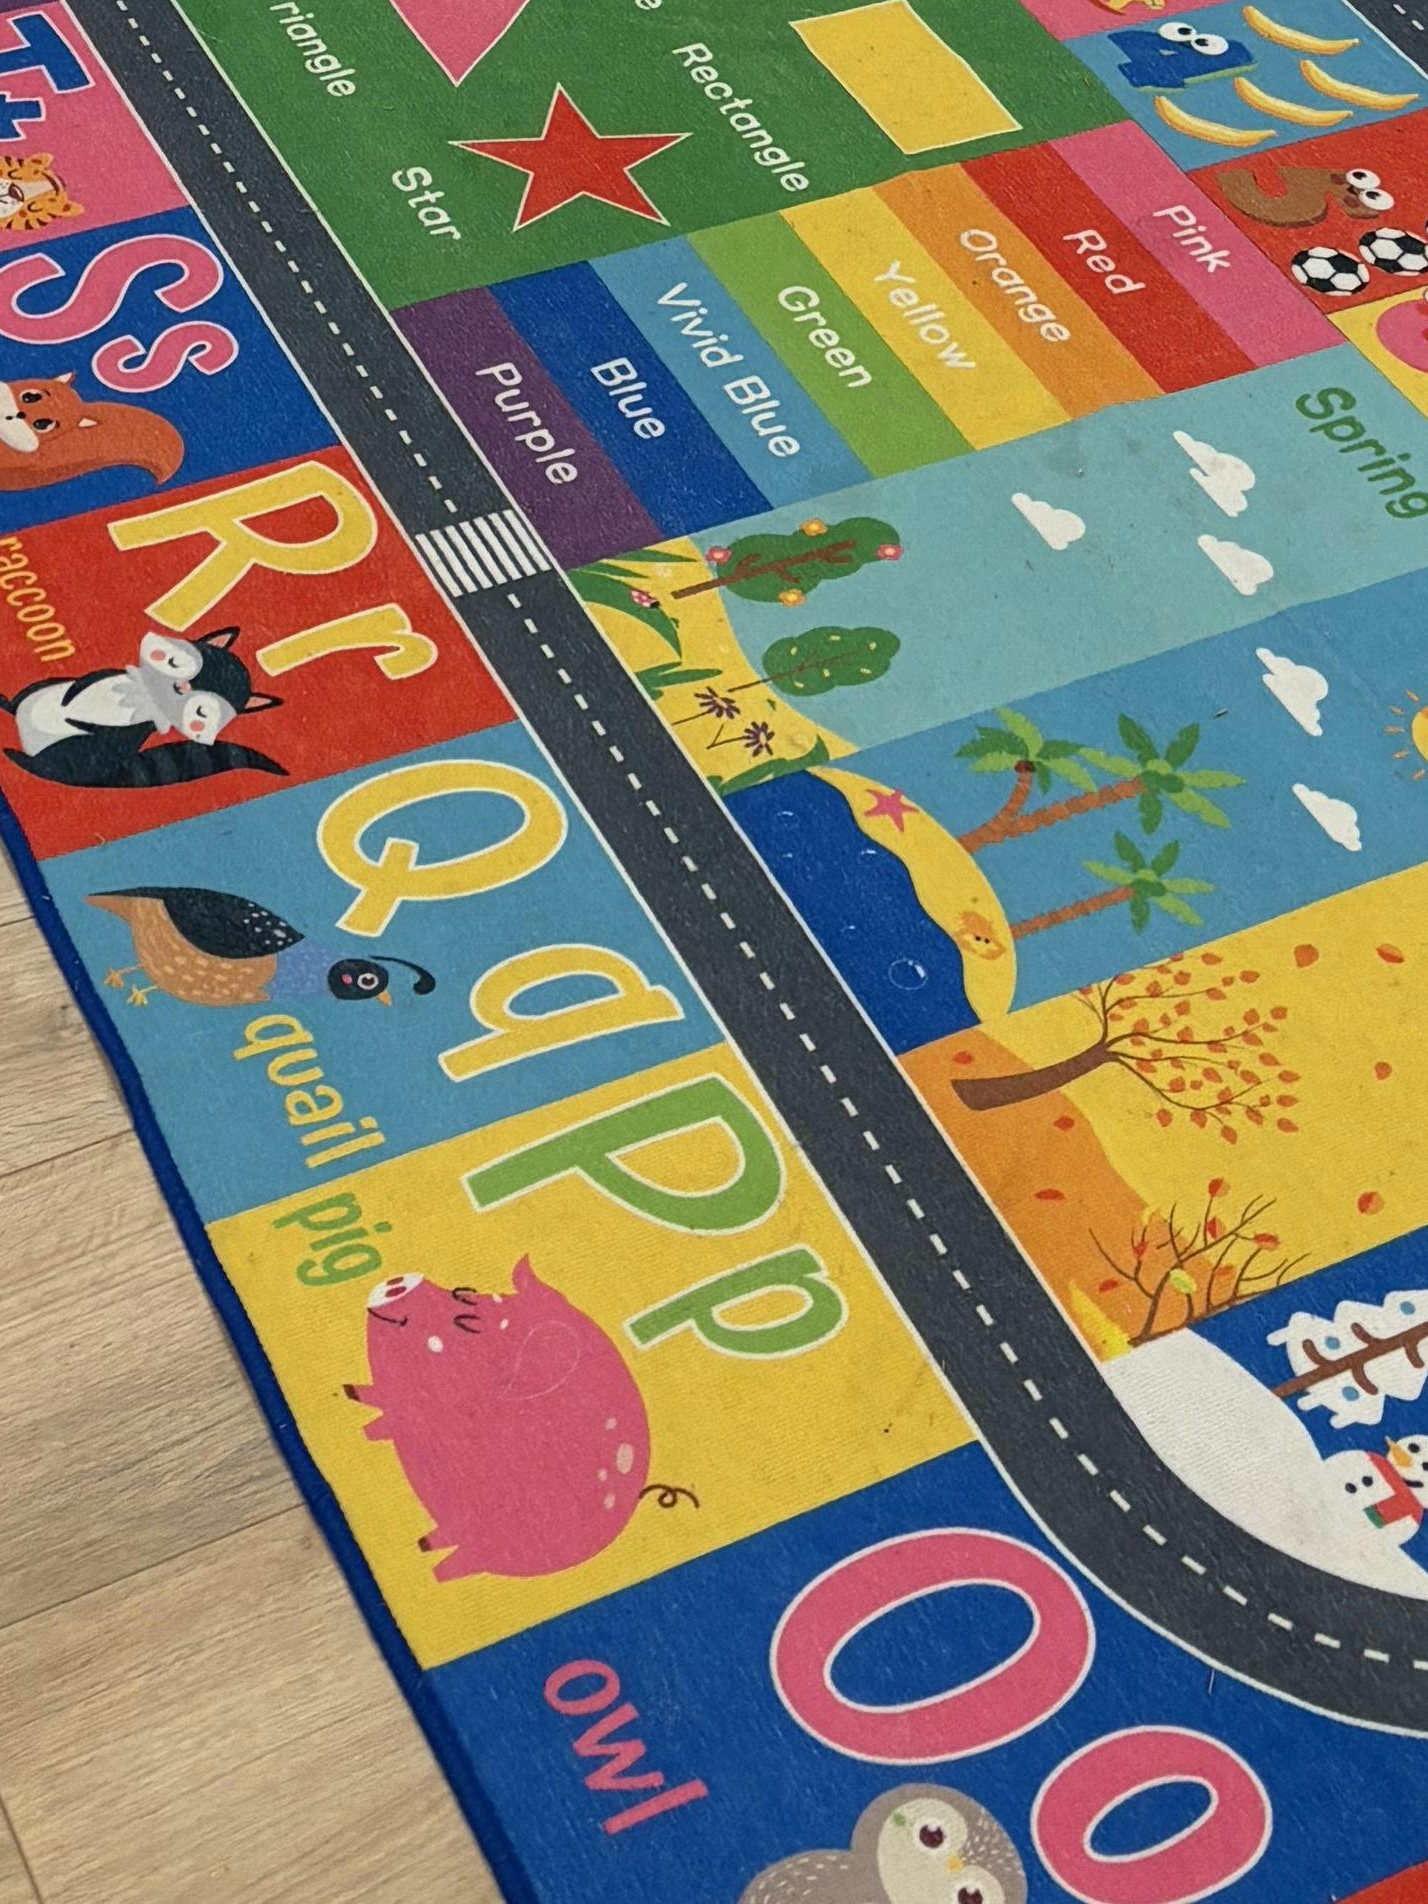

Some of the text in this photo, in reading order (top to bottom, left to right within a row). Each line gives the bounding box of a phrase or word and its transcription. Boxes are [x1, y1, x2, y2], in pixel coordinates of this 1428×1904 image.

[672, 43, 809, 192] Rectangle
[391, 166, 461, 242] Star
[1153, 205, 1231, 275] Pink
[872, 260, 977, 374] Yellow
[958, 228, 1071, 345] Orange
[1061, 230, 1146, 297] Red
[656, 283, 802, 460] Vivid Blue
[776, 285, 873, 390] Green
[476, 363, 578, 486] Purple
[591, 356, 666, 441] Blue
[106, 459, 438, 681] Rr
[233, 1013, 384, 1168] quail
[272, 1192, 393, 1288] pig
[460, 1071, 848, 1360] Pp
[544, 1659, 708, 1835] owl
